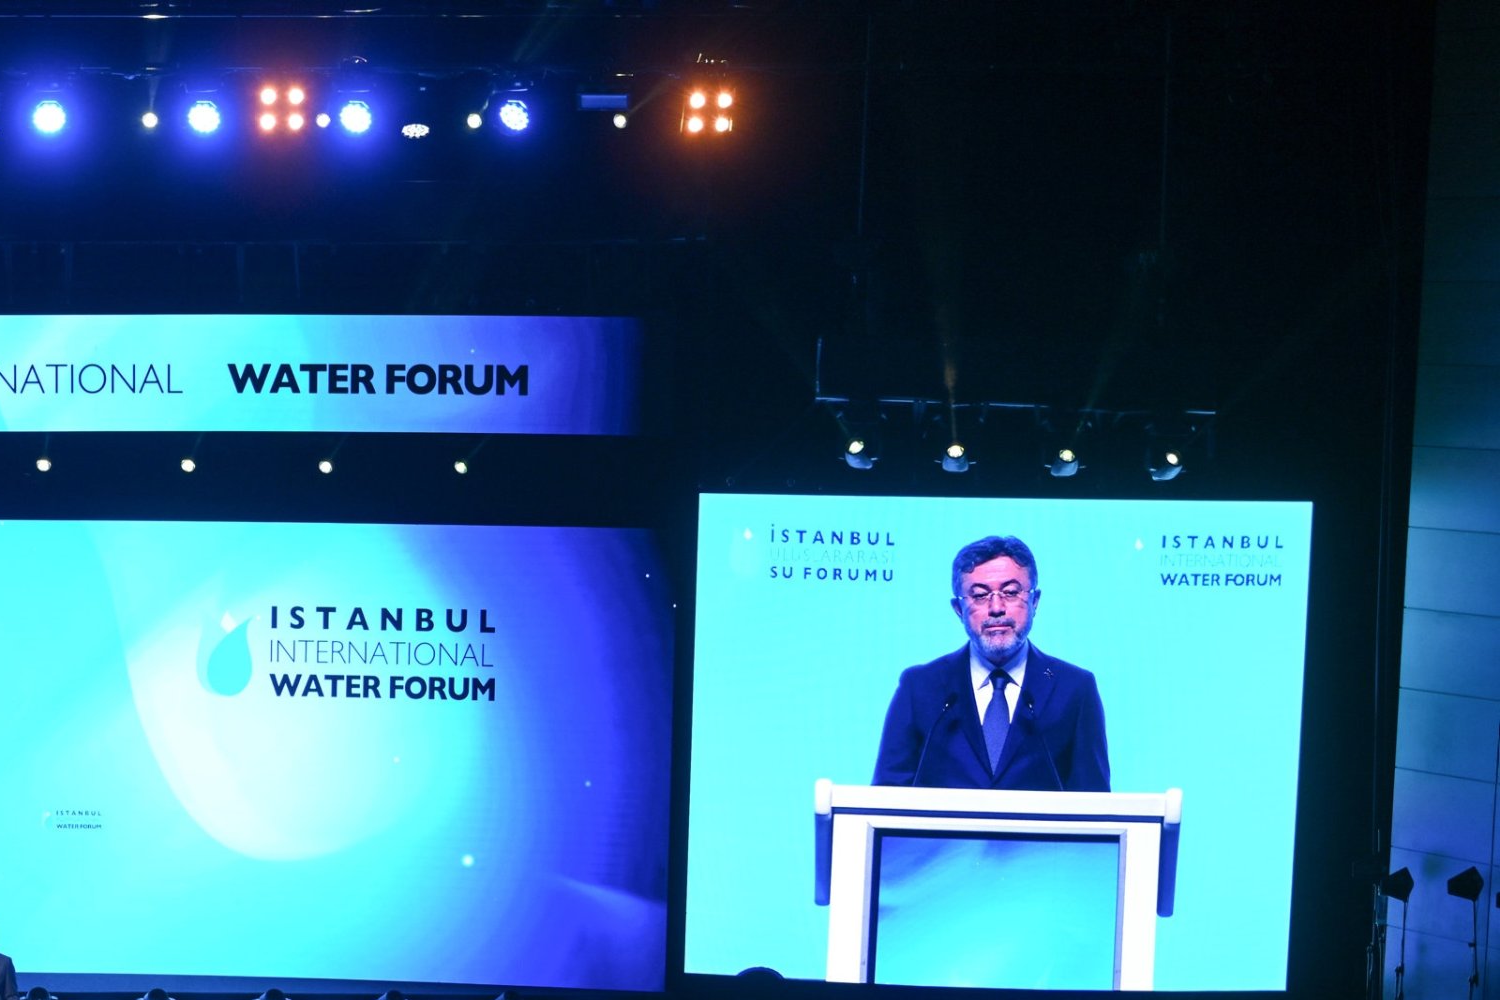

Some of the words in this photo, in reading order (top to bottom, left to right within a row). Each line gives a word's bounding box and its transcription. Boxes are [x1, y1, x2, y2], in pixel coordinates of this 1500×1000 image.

[227, 363, 376, 394] WATER
[385, 363, 530, 396] FORUM
[770, 523, 895, 546] İSTANBUL
[1161, 535, 1284, 549] ISTANBUL
[770, 565, 793, 579] SU
[803, 566, 893, 582] FORUMU
[1160, 573, 1220, 586] WATER
[1224, 573, 1282, 586] FORUM
[270, 605, 496, 634] ISTANBUL
[269, 639, 495, 668] INTERNATIONAL
[269, 673, 382, 699] WATER
[389, 674, 496, 702] FORUM
